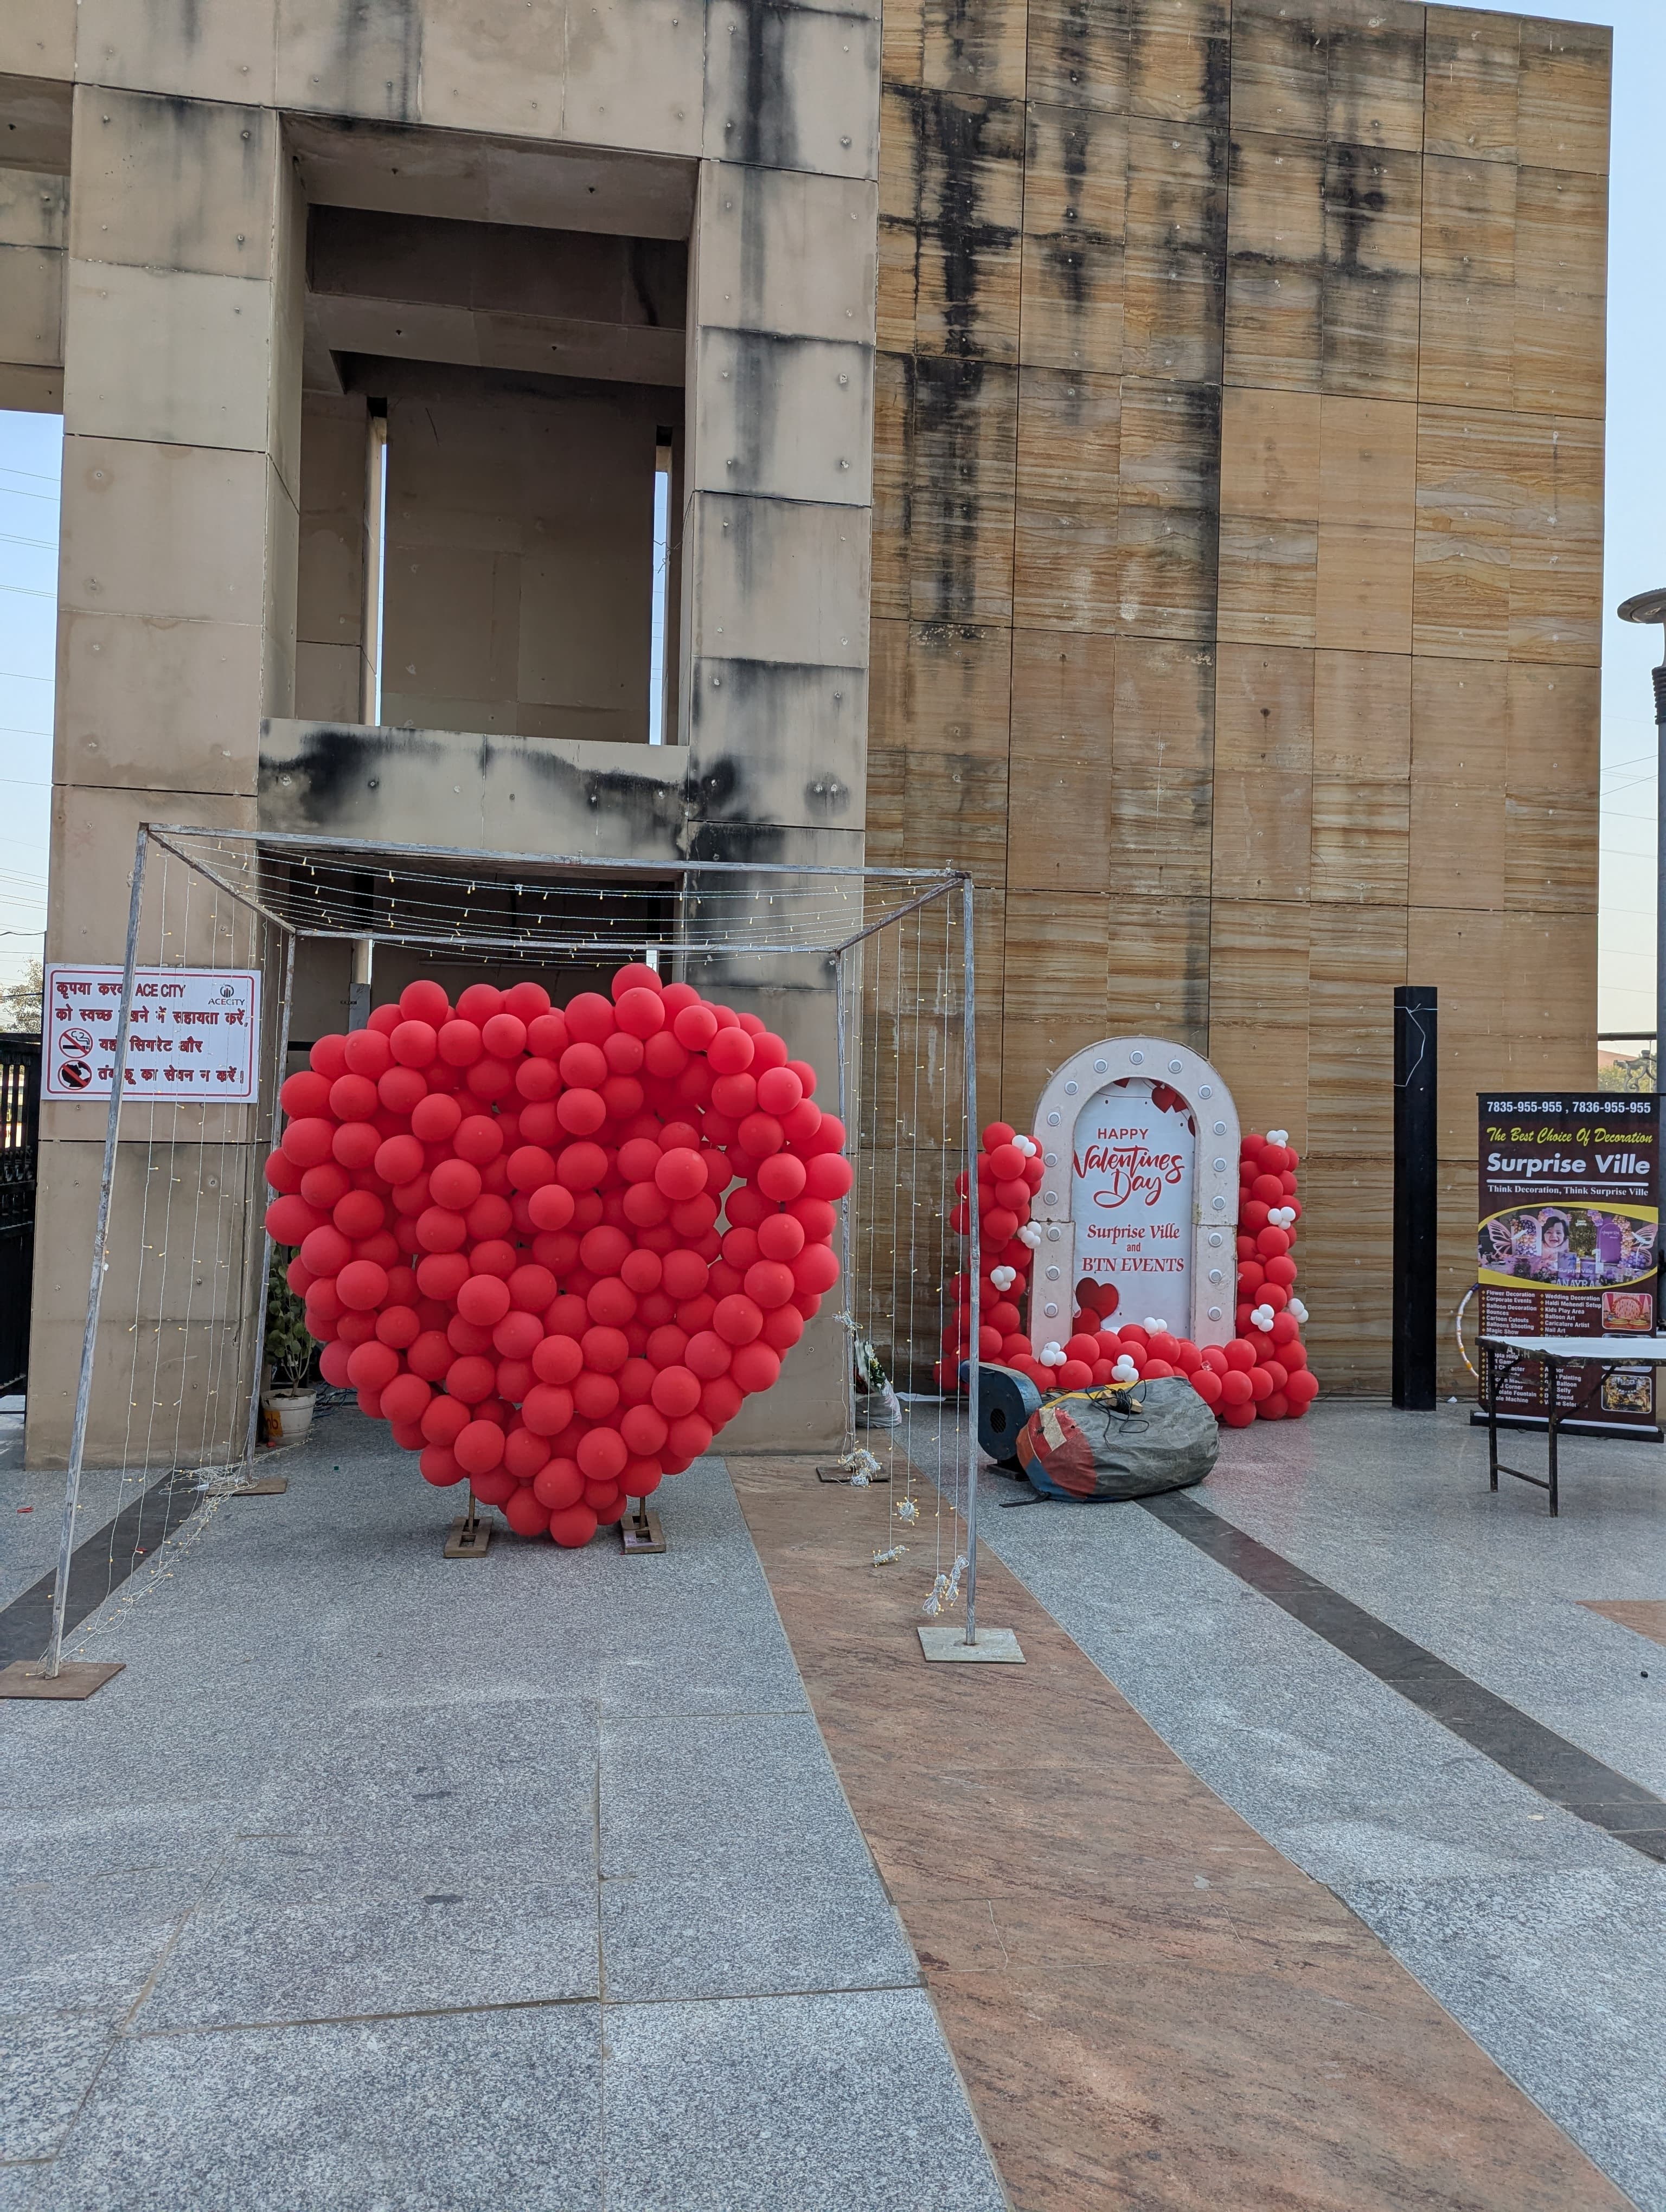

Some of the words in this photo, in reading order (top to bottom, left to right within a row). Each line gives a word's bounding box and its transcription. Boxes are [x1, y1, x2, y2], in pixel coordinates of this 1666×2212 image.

[55, 982, 92, 999] कृपया
[135, 983, 158, 997] ACE
[161, 983, 186, 998] CITY
[55, 1004, 73, 1021] को
[79, 1008, 113, 1022] स्वच्छ
[155, 1006, 167, 1024] में
[172, 1011, 220, 1025] सहायता
[129, 1035, 173, 1052] सिगरेट
[179, 1036, 203, 1053] और
[140, 1069, 159, 1081] का
[163, 1064, 194, 1082] सेवन
[199, 1070, 211, 1082] न
[1486, 1101, 1562, 1113] 7835-955-955
[1573, 1102, 1651, 1114] 7836-955-955
[1097, 1128, 1149, 1140] HAPPY
[1486, 1127, 1507, 1142] The
[1510, 1127, 1534, 1142] Best
[1536, 1127, 1572, 1144] Choice
[1576, 1128, 1591, 1147] Of
[1593, 1128, 1654, 1144] Decoration
[1073, 1144, 1186, 1184] Valentines
[1486, 1152, 1587, 1178] Surprise
[1594, 1153, 1651, 1175] Ville
[1093, 1168, 1162, 1209] Day
[1488, 1185, 1513, 1193] Think
[1514, 1185, 1562, 1195] Decoration,
[1564, 1186, 1588, 1195] Think
[1590, 1187, 1626, 1197] Surprise
[1628, 1188, 1649, 1197] Ville
[1087, 1224, 1146, 1244] Surprise
[1149, 1223, 1181, 1239] Ville
[1126, 1242, 1141, 1252] and
[1081, 1257, 1118, 1272] BTN
[1121, 1258, 1184, 1272] EVENTS
[1559, 1374, 1582, 1382] Painting
